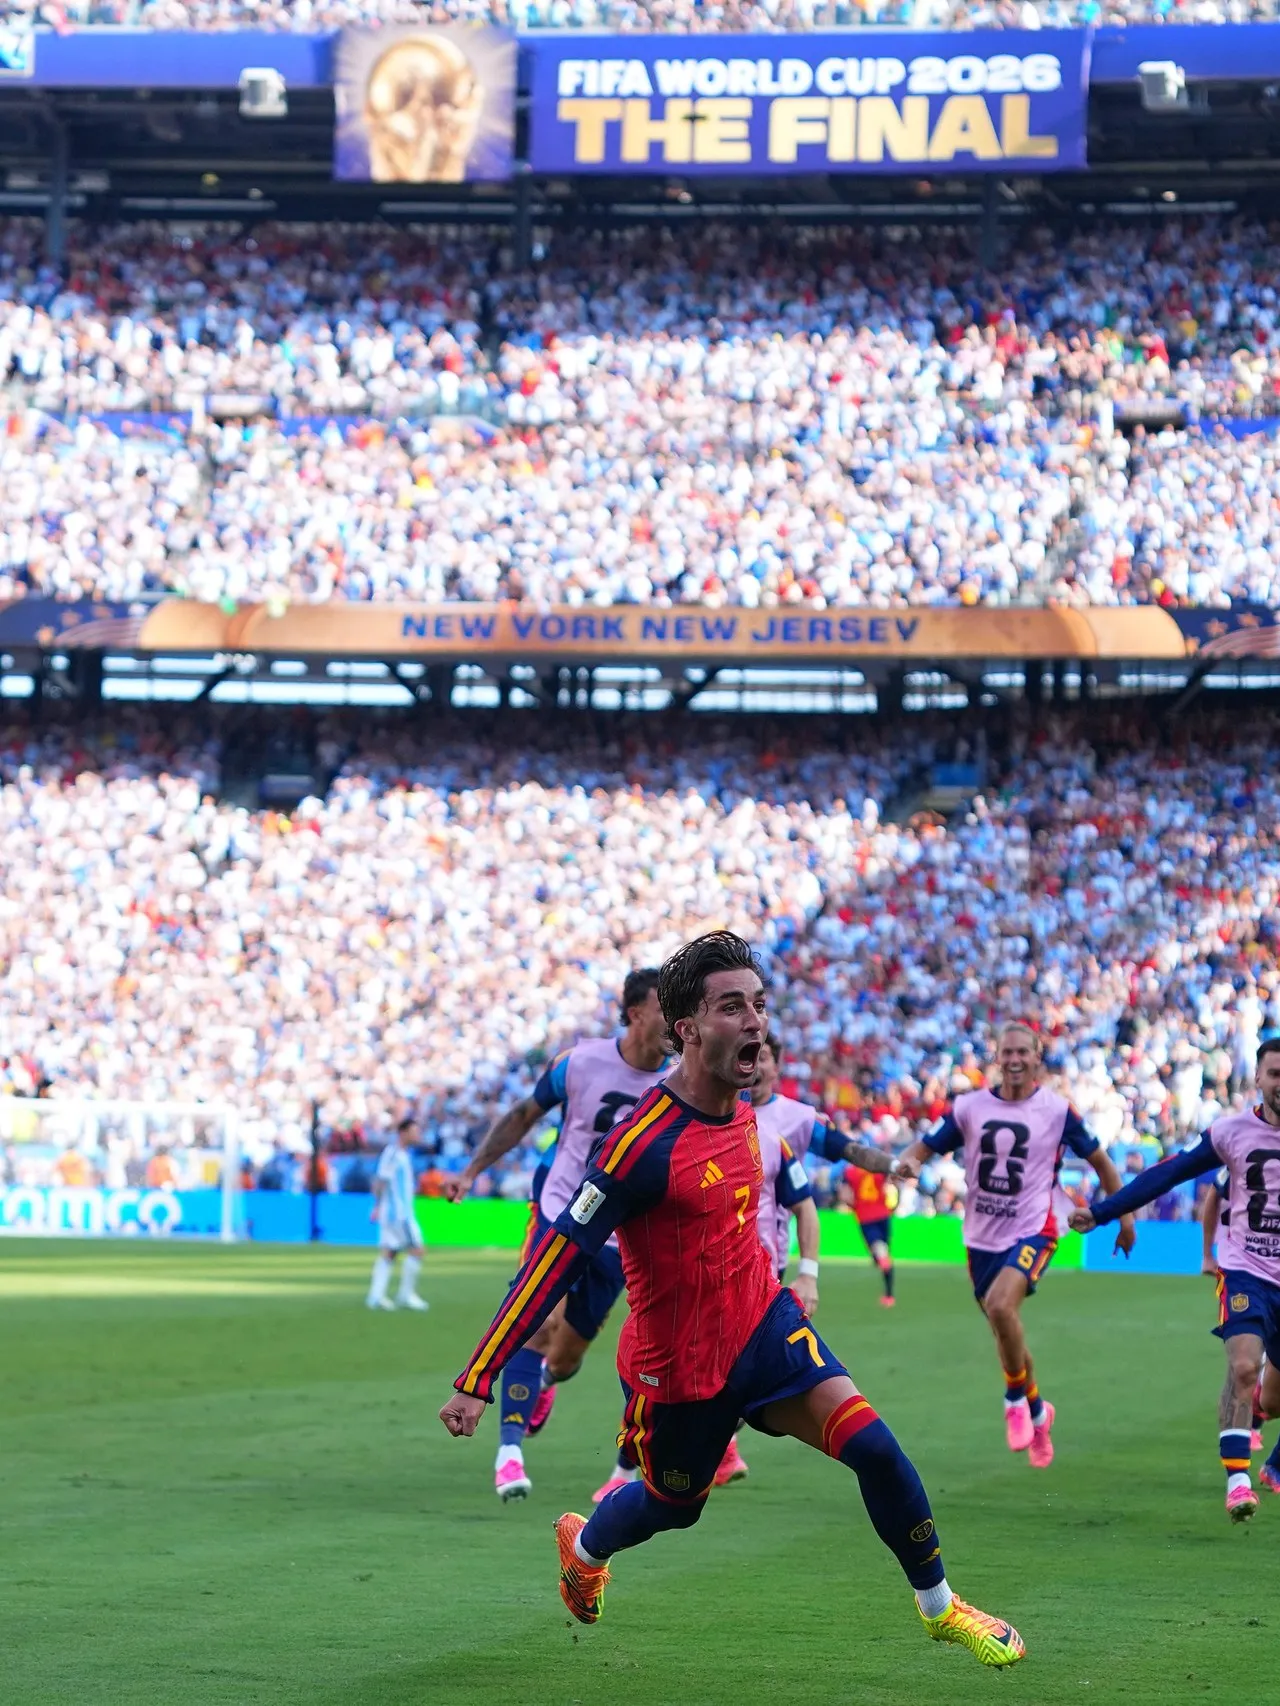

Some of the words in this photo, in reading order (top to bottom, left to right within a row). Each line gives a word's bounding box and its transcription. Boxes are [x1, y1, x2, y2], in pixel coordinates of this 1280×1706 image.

[557, 59, 654, 96] FIFA
[653, 57, 814, 96] WORLD
[815, 57, 907, 95] CUP
[907, 53, 1063, 94] 2026
[557, 96, 753, 164] THE
[767, 93, 1059, 163] FINAL
[402, 613, 496, 640] NEW
[510, 613, 626, 641] YORK
[640, 614, 739, 642] NEW
[752, 615, 920, 642] JERSEY
[987, 1178, 1011, 1191] FIFA
[0, 1187, 183, 1237] amco
[734, 1185, 750, 1234] 7
[1245, 1234, 1280, 1247] WORLD
[786, 1326, 827, 1368] 7
